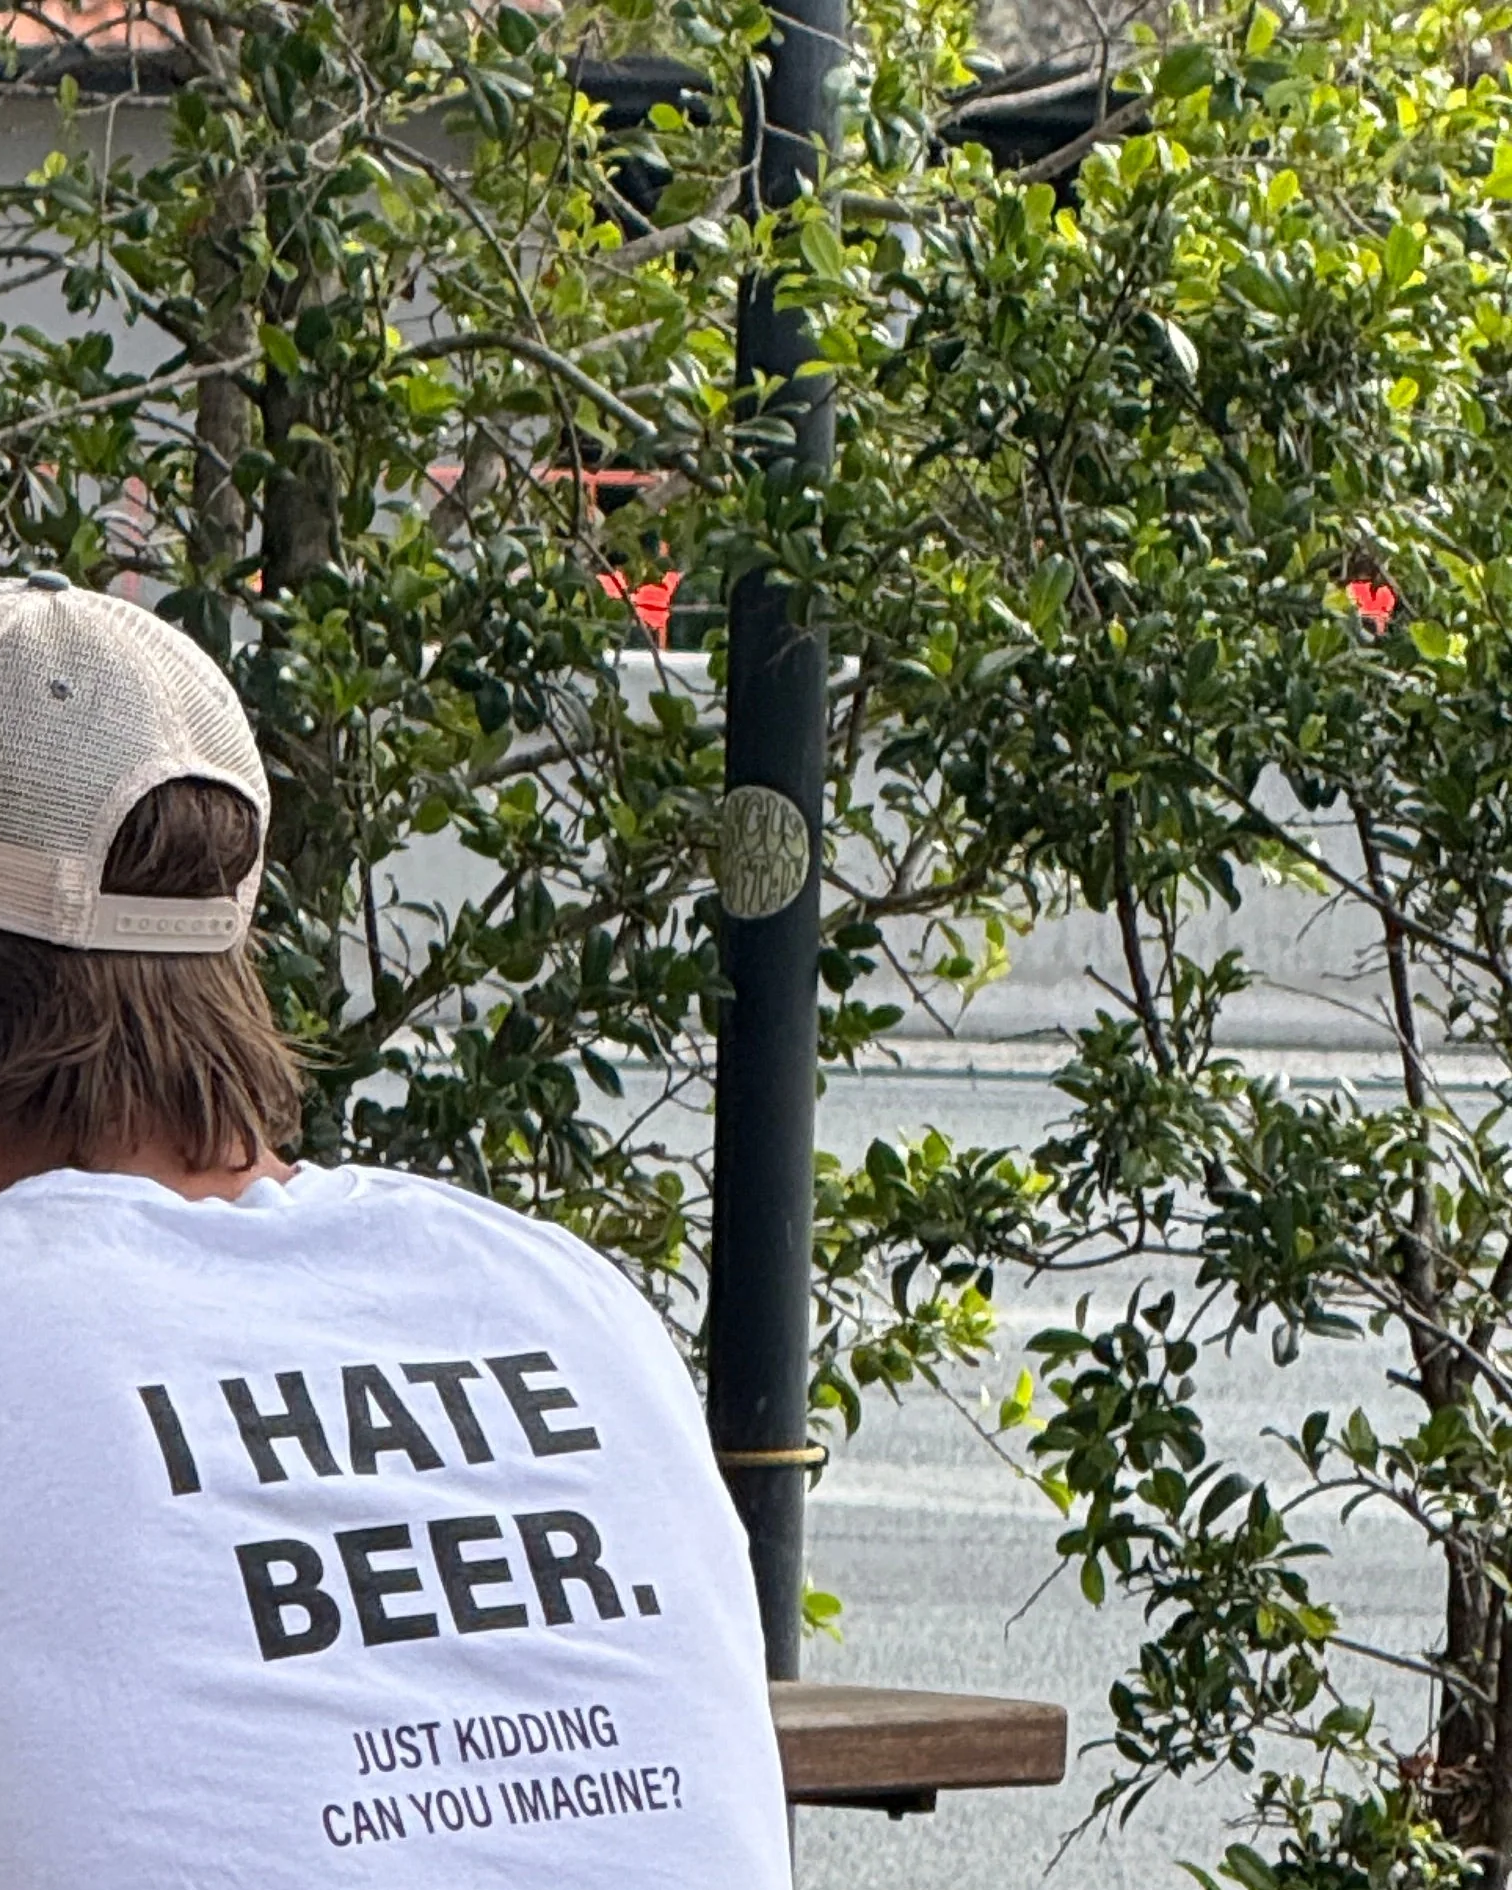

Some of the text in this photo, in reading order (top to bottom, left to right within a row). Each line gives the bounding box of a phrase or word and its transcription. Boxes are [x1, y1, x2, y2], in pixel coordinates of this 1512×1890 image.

[137, 1351, 601, 1496] I HATE
[234, 1509, 661, 1662] BEER.
[353, 1703, 619, 1775] JUST KIDDING
[321, 1766, 682, 1847] CAN YOU IMAGINE?
